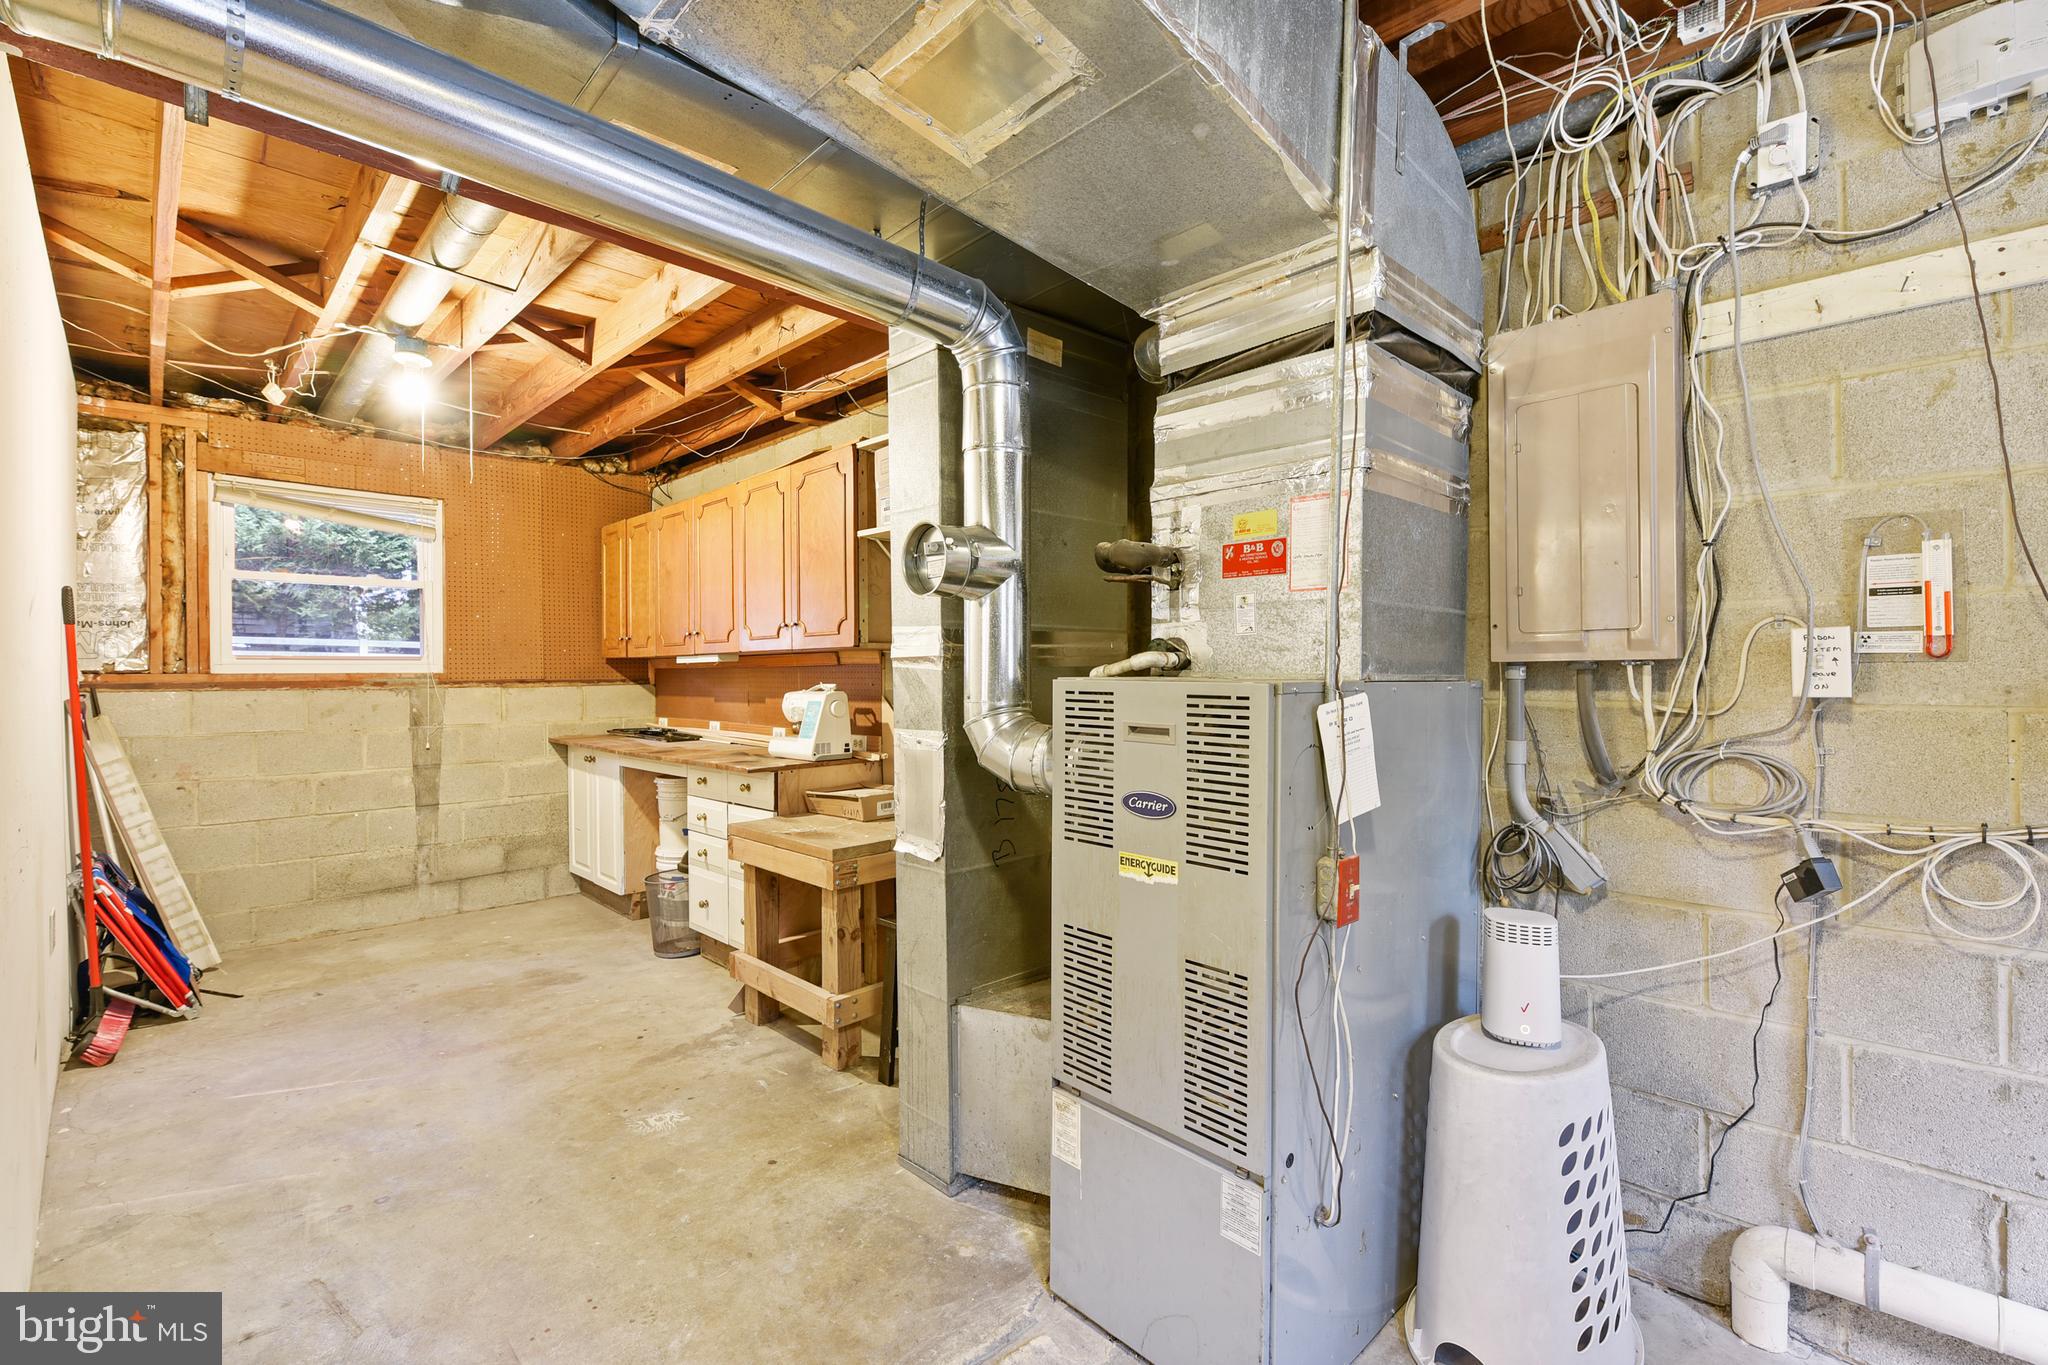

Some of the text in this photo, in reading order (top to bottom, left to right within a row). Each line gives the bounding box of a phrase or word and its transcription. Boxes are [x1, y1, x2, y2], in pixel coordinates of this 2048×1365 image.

[1243, 542, 1264, 553] B&B
[1128, 796, 1169, 812] Carrier
[1119, 855, 1177, 877] ENERGYGUIDE
